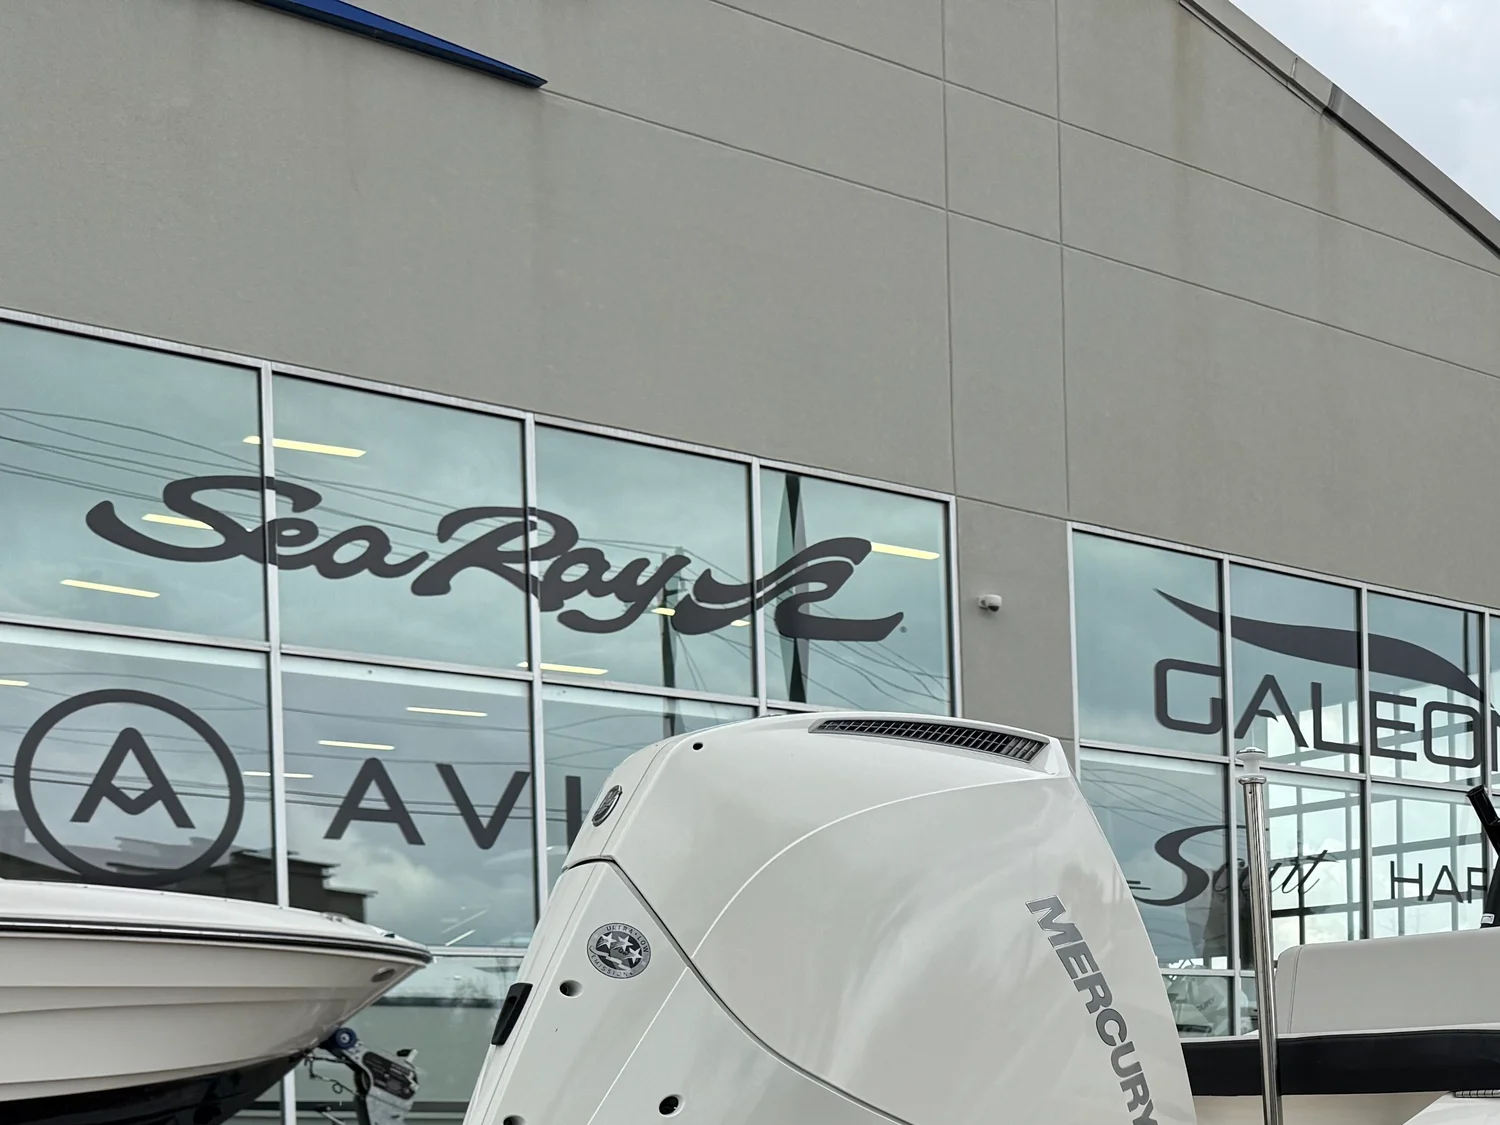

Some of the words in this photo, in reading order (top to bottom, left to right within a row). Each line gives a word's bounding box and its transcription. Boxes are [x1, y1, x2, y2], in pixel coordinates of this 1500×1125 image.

[85, 475, 428, 580] Sea
[410, 505, 693, 635] Ray
[636, 935, 650, 954] LOW
